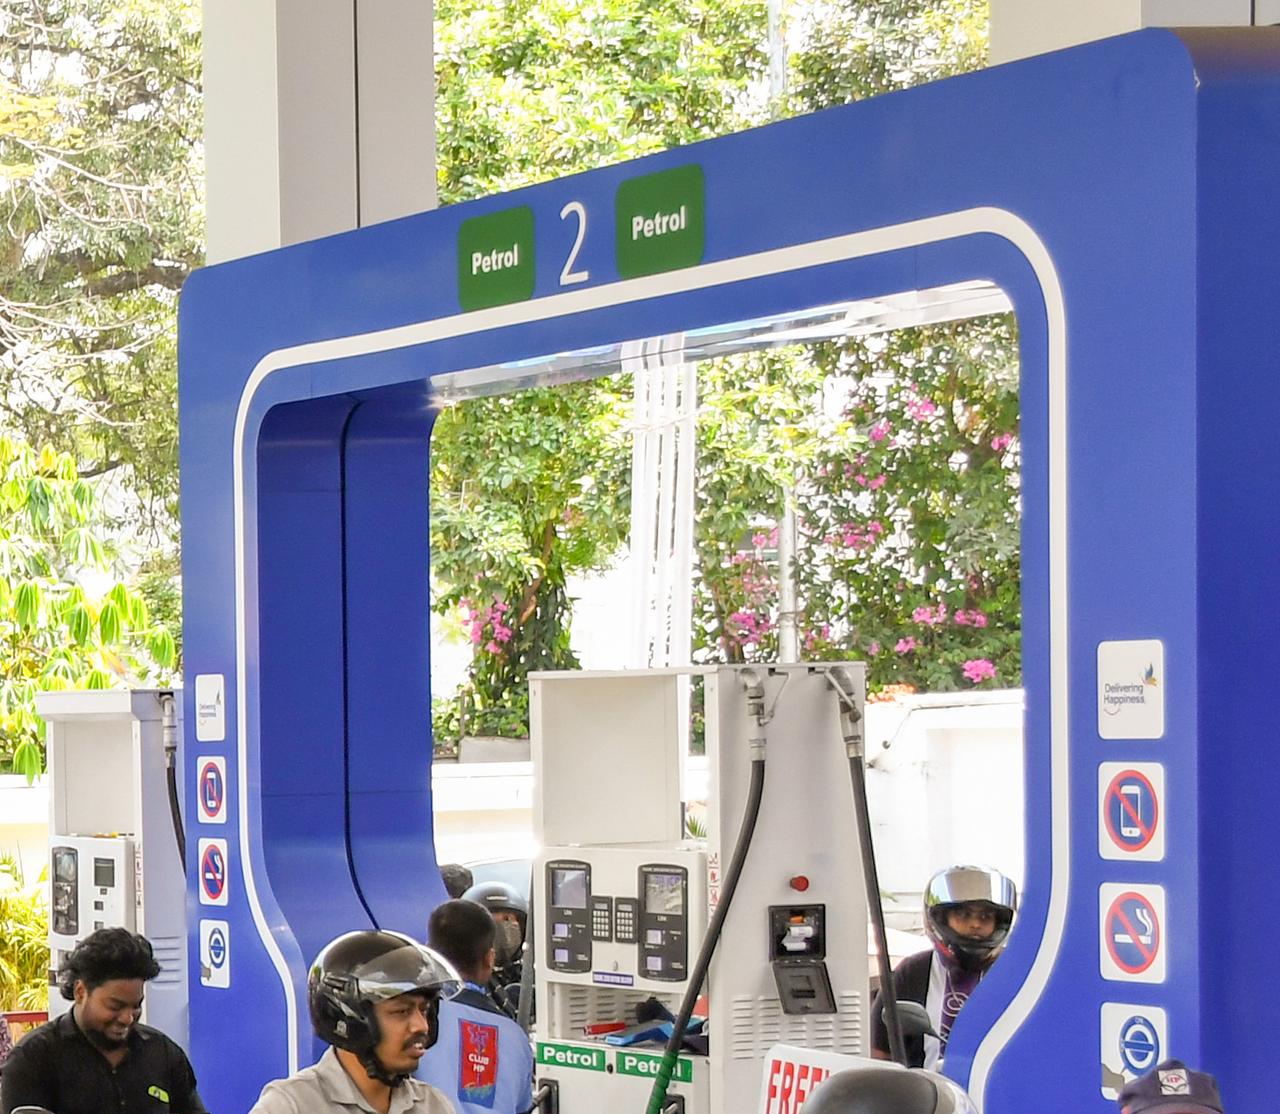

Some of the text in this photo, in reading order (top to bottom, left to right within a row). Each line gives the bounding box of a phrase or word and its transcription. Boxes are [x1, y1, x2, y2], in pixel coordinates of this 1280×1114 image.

[632, 205, 687, 240] Petrol
[559, 201, 589, 286] 2
[471, 244, 519, 275] Petrol
[1104, 682, 1144, 694] Delivering
[468, 1053, 490, 1065] CLUB
[543, 1046, 597, 1067] Petrol
